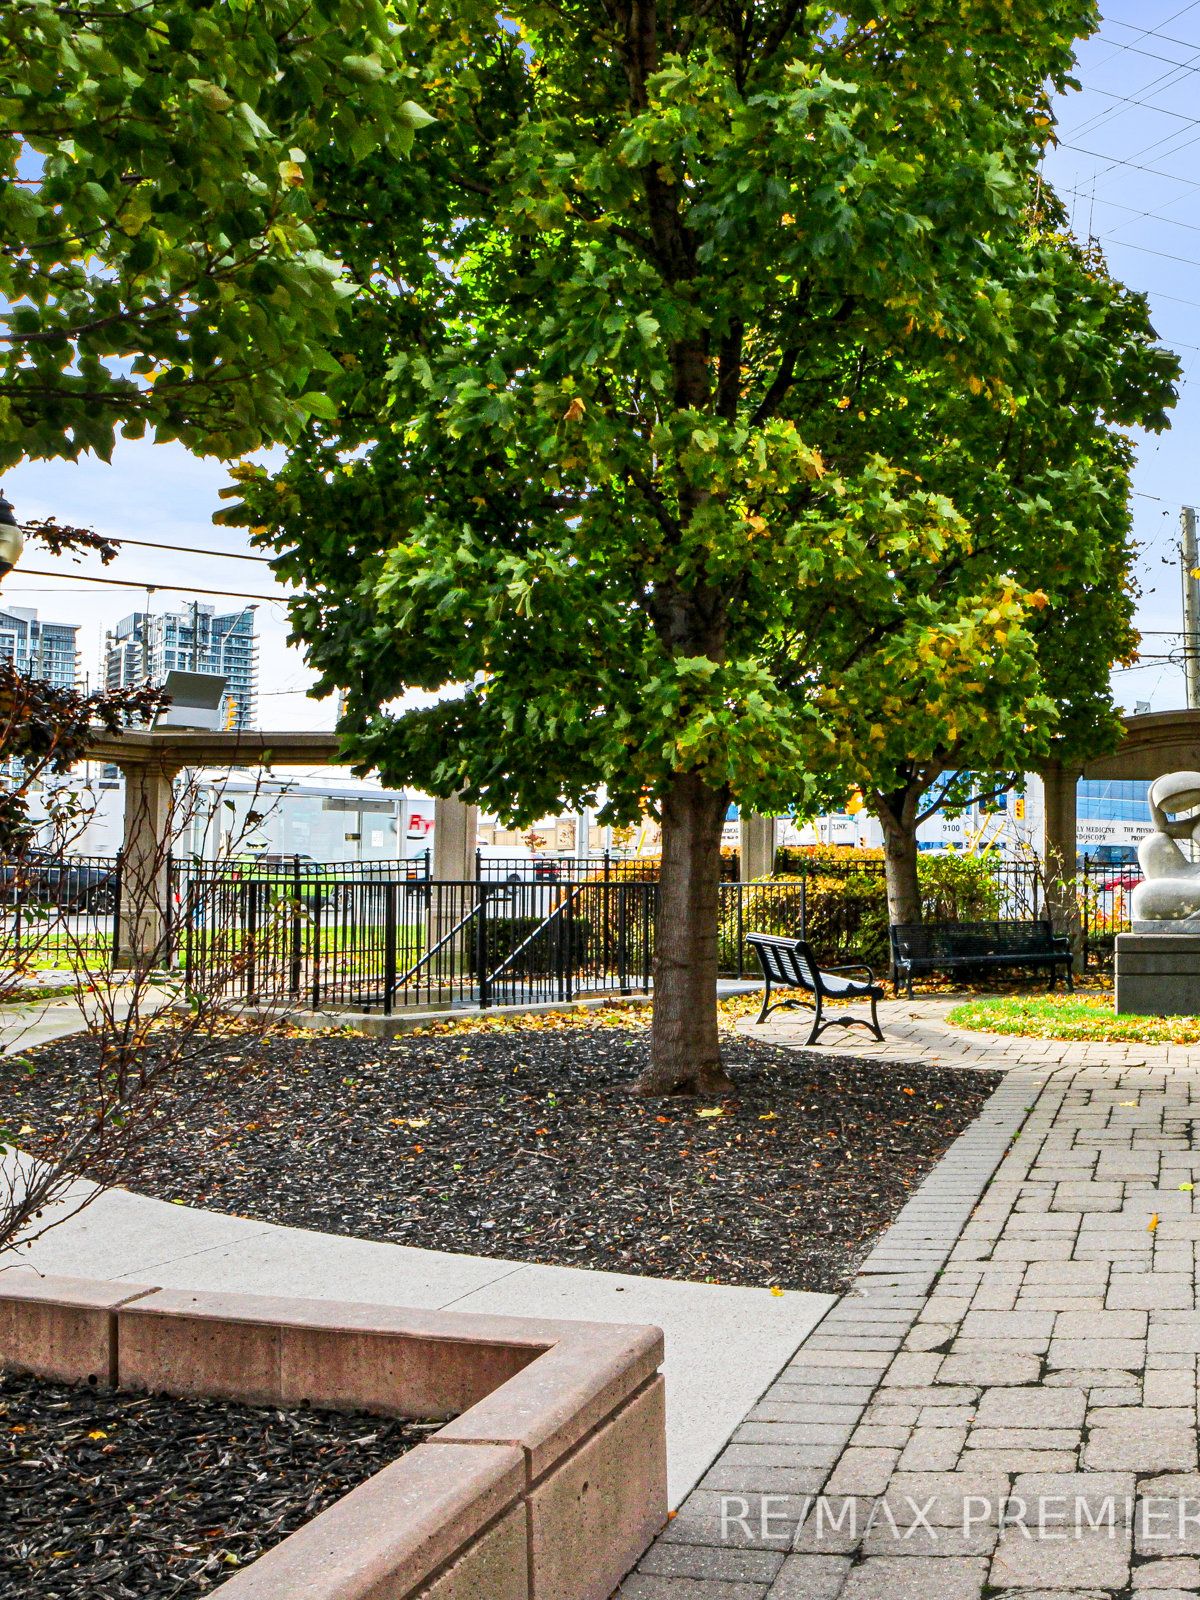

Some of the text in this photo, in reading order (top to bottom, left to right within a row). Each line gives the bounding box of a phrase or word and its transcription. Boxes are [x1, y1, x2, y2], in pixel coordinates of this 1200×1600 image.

[408, 815, 435, 834] Ry
[942, 824, 960, 832] 9100
[1086, 826, 1116, 834] MEDICINE
